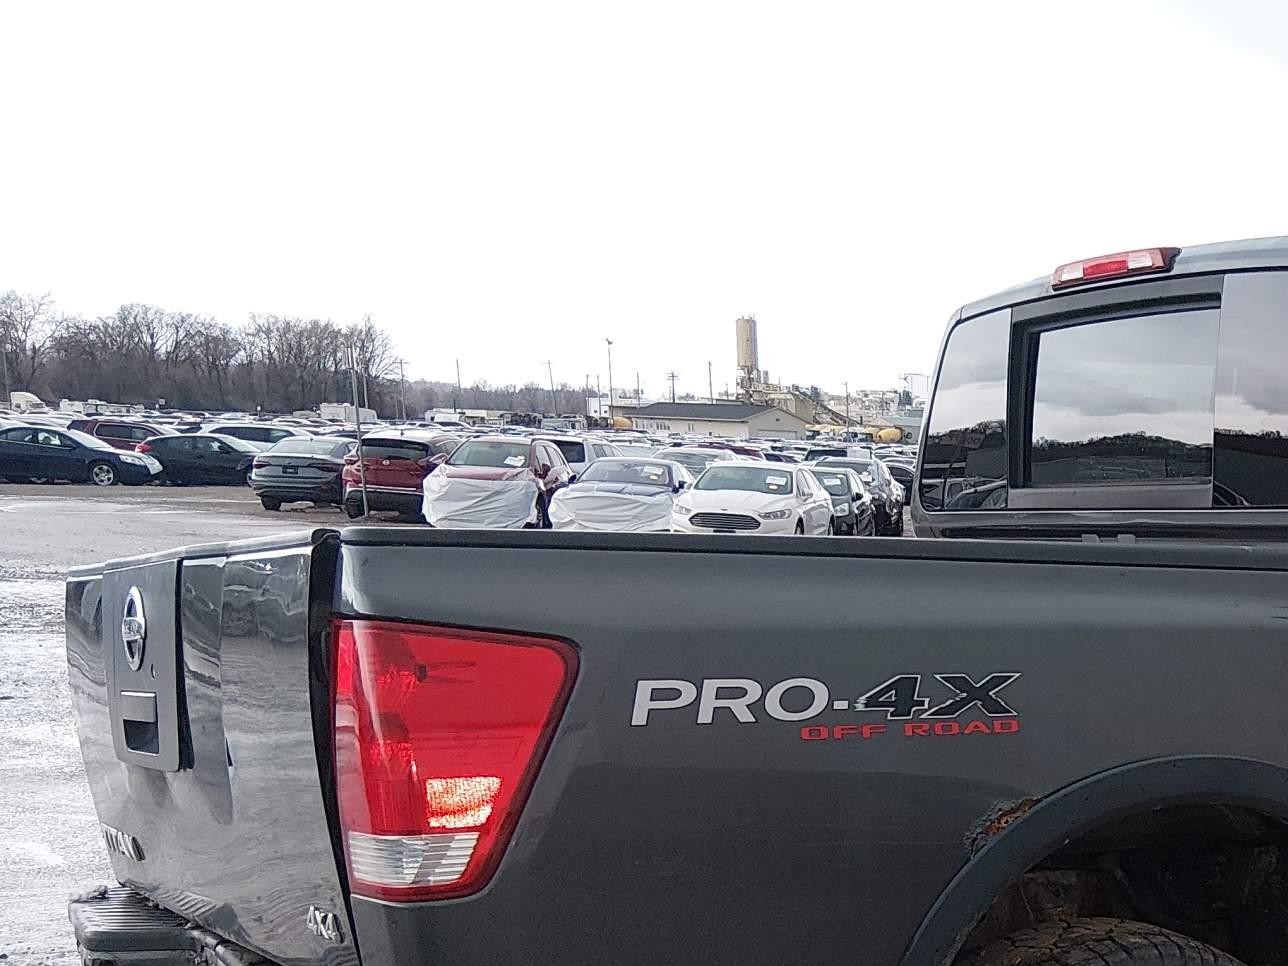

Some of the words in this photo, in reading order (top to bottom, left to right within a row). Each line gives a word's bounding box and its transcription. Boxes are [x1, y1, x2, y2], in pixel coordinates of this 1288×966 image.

[630, 672, 1022, 727] PRO-4X
[800, 723, 887, 741] OFF
[903, 719, 1021, 738] ROAD
[306, 904, 346, 944] 4X4
